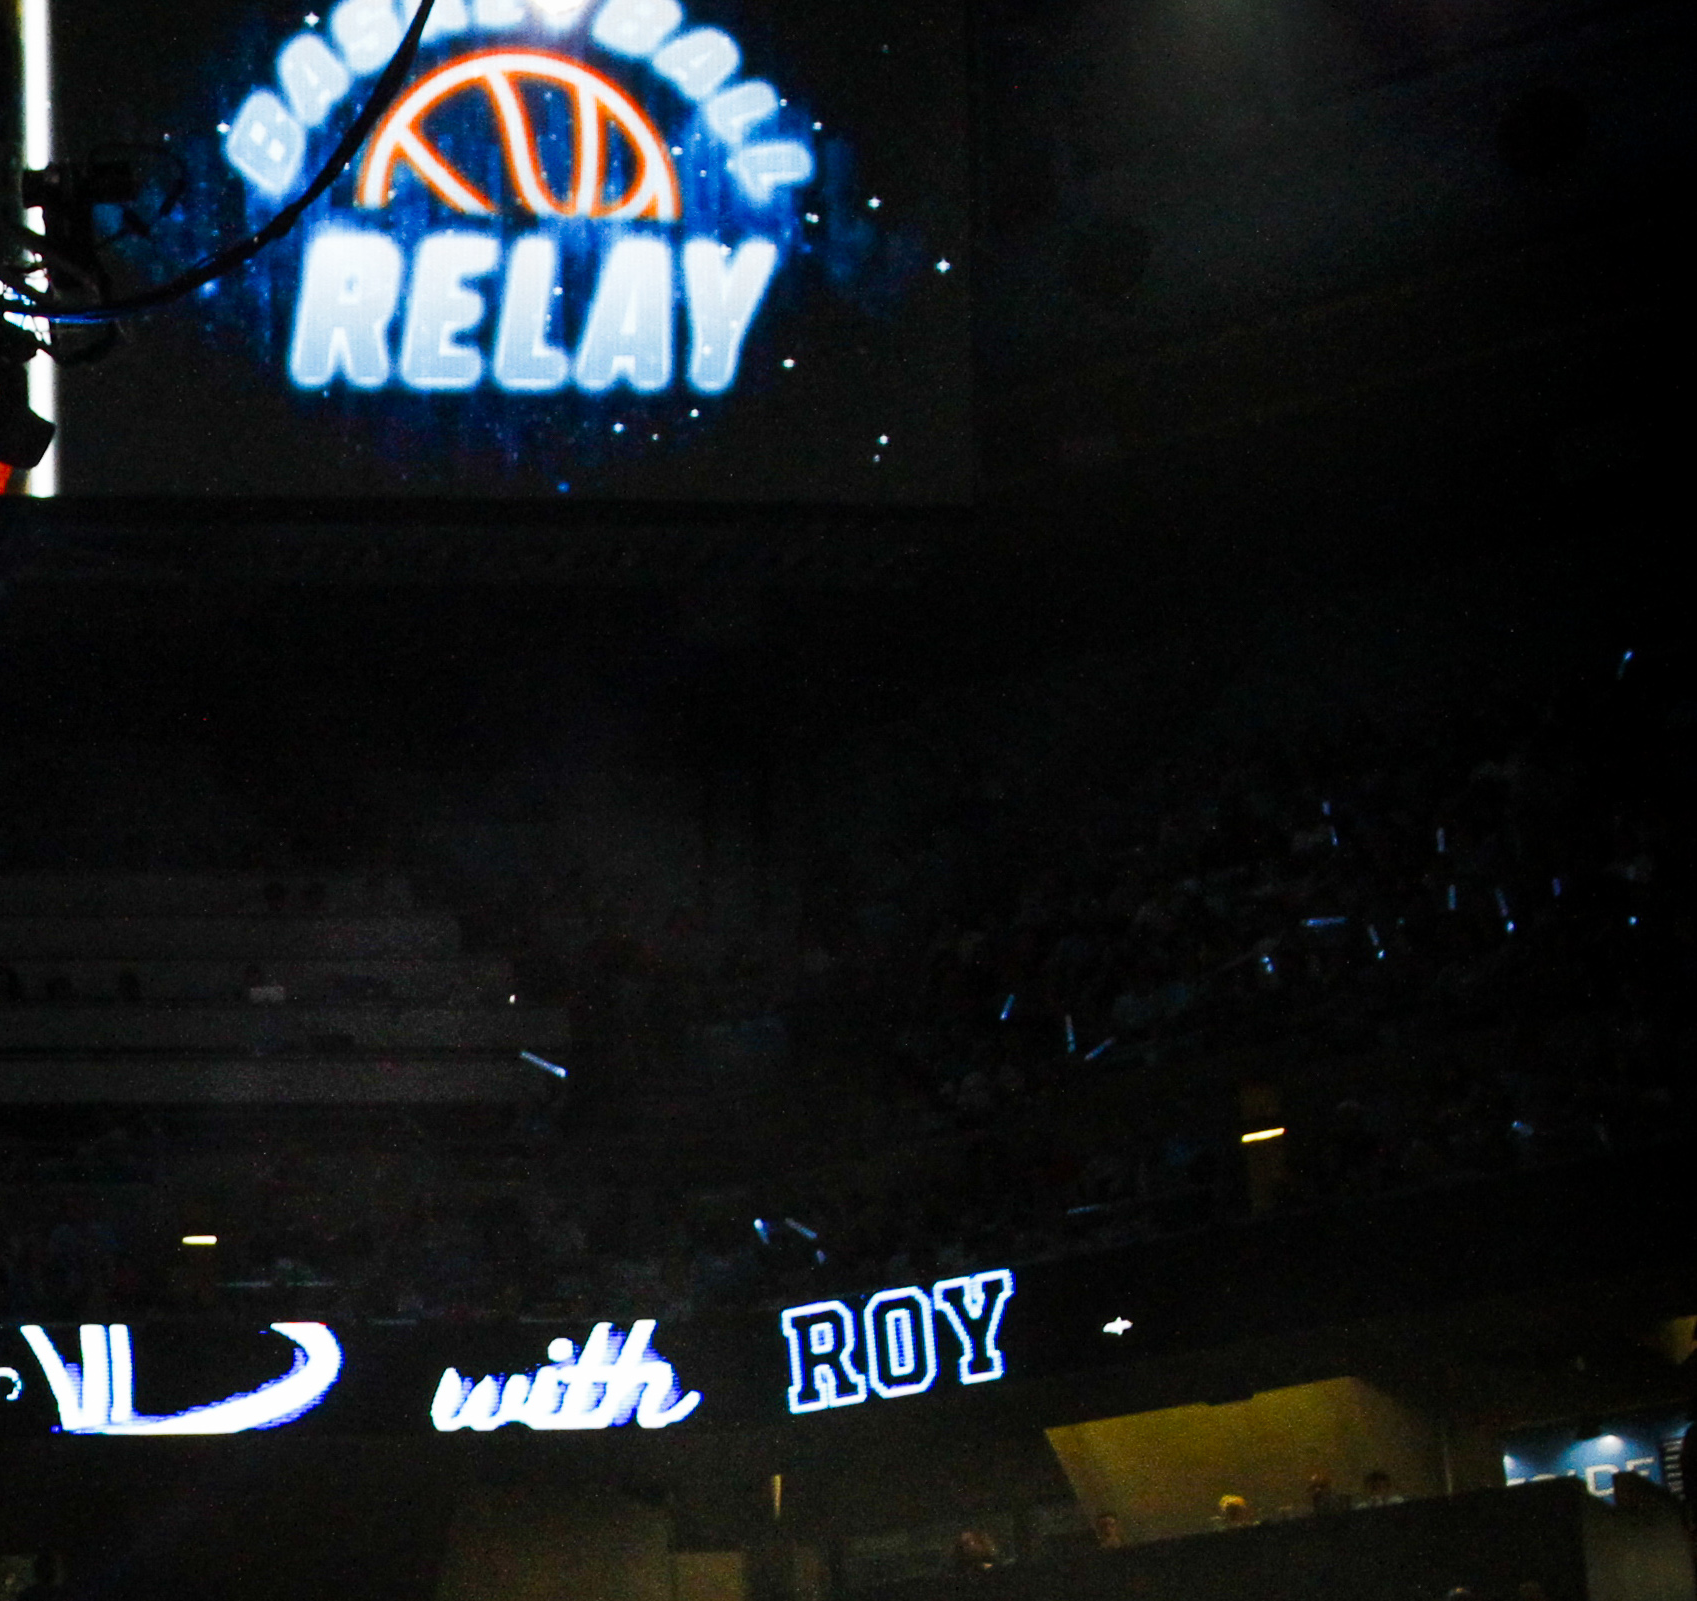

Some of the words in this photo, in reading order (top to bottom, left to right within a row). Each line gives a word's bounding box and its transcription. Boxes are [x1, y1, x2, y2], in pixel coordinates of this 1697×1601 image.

[290, 231, 778, 392] RELAY
[431, 1319, 703, 1432] with
[781, 1268, 1015, 1415] ROY
